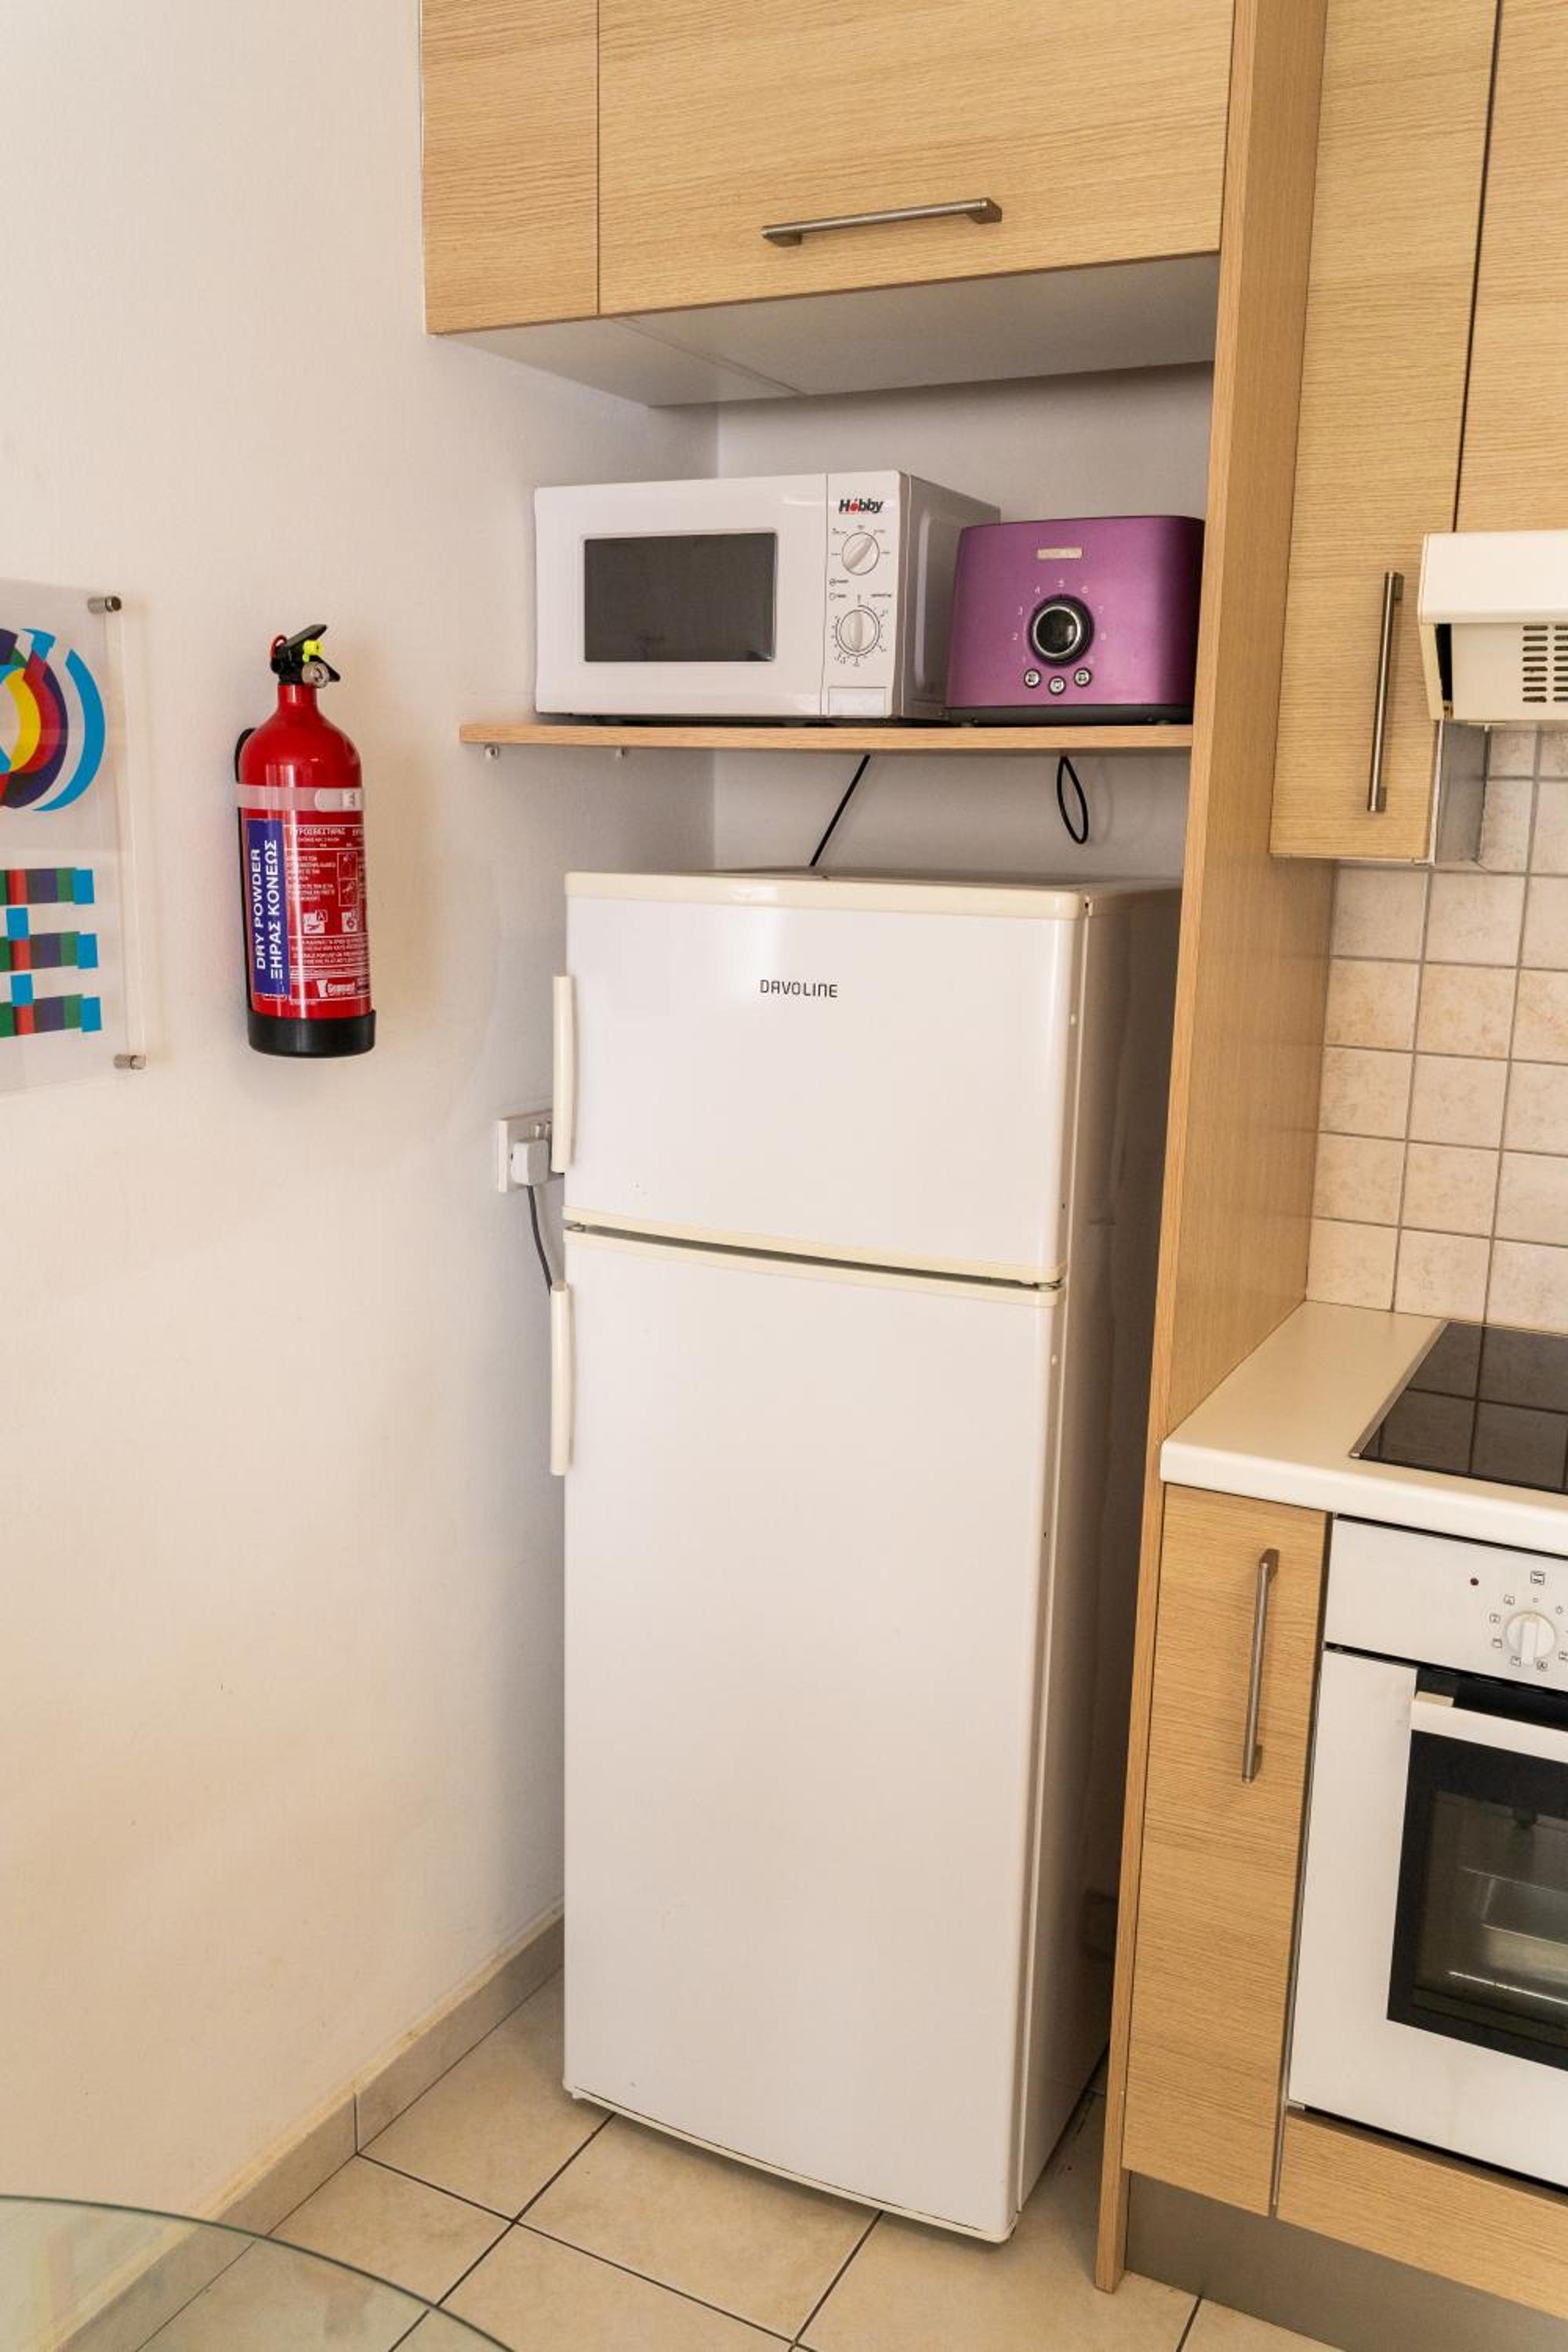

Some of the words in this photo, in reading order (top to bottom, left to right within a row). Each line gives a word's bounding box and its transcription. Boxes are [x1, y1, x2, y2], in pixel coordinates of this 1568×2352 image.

[839, 499, 884, 514] Hobby
[251, 849, 263, 928] POWDER
[264, 840, 281, 916] ΚΟΝΕΩΣ
[255, 933, 266, 970] DRY
[267, 920, 283, 979] ΞΗΡΑΣ
[760, 979, 838, 998] DAVOLINE
